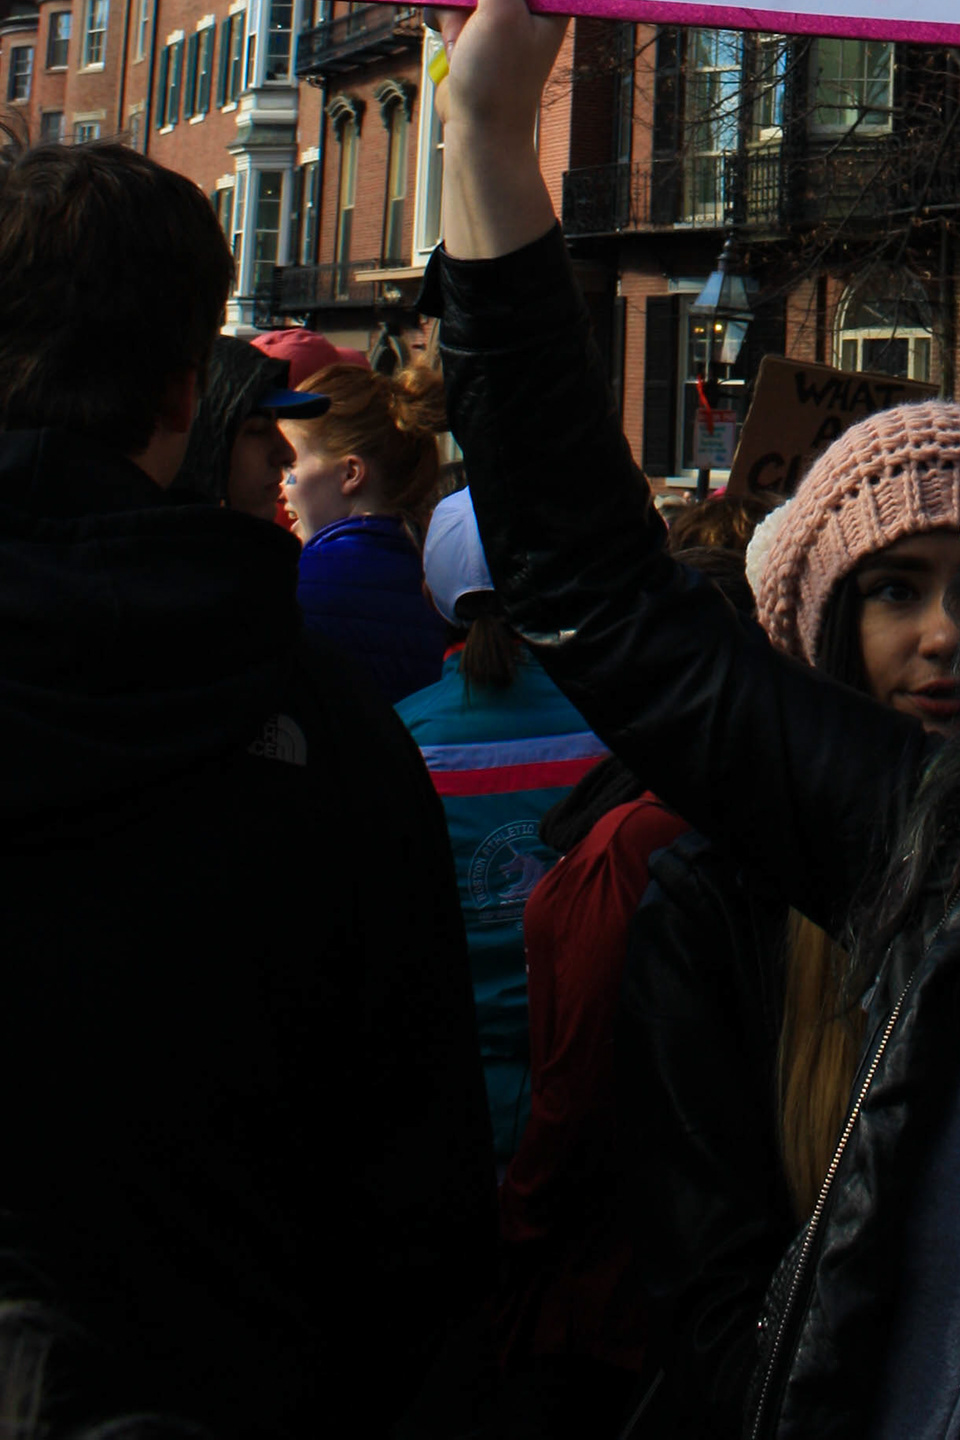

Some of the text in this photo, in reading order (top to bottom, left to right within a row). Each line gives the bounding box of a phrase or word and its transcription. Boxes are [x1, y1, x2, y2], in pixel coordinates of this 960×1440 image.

[795, 371, 904, 410] WHAT
[471, 824, 535, 903] BOSTON ATHLETIC
